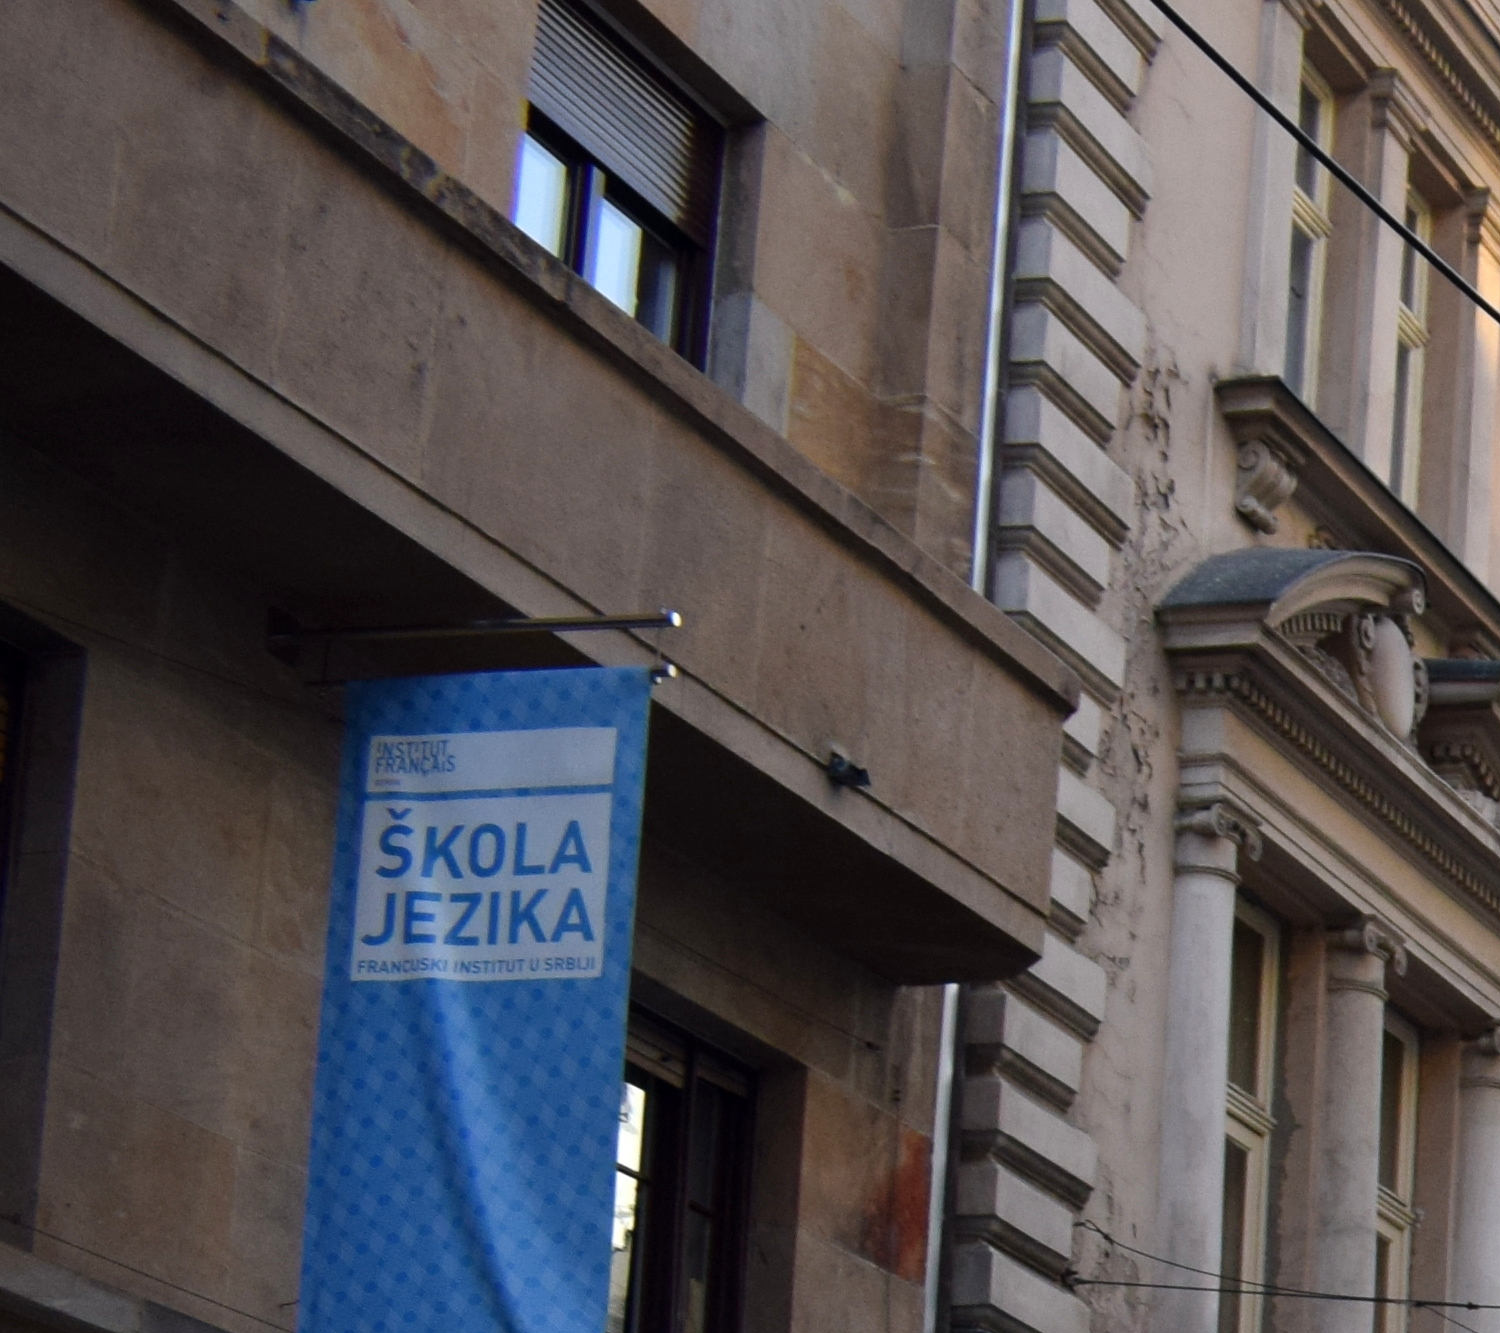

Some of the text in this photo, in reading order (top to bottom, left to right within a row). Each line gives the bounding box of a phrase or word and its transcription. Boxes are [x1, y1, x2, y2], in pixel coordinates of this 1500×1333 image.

[376, 739, 450, 758] INSTITUT
[375, 807, 593, 880] ŠKOLA
[361, 887, 595, 946] JEZIKA
[357, 956, 596, 975] FRANCUSKI INSTITUT U SRBIJI
